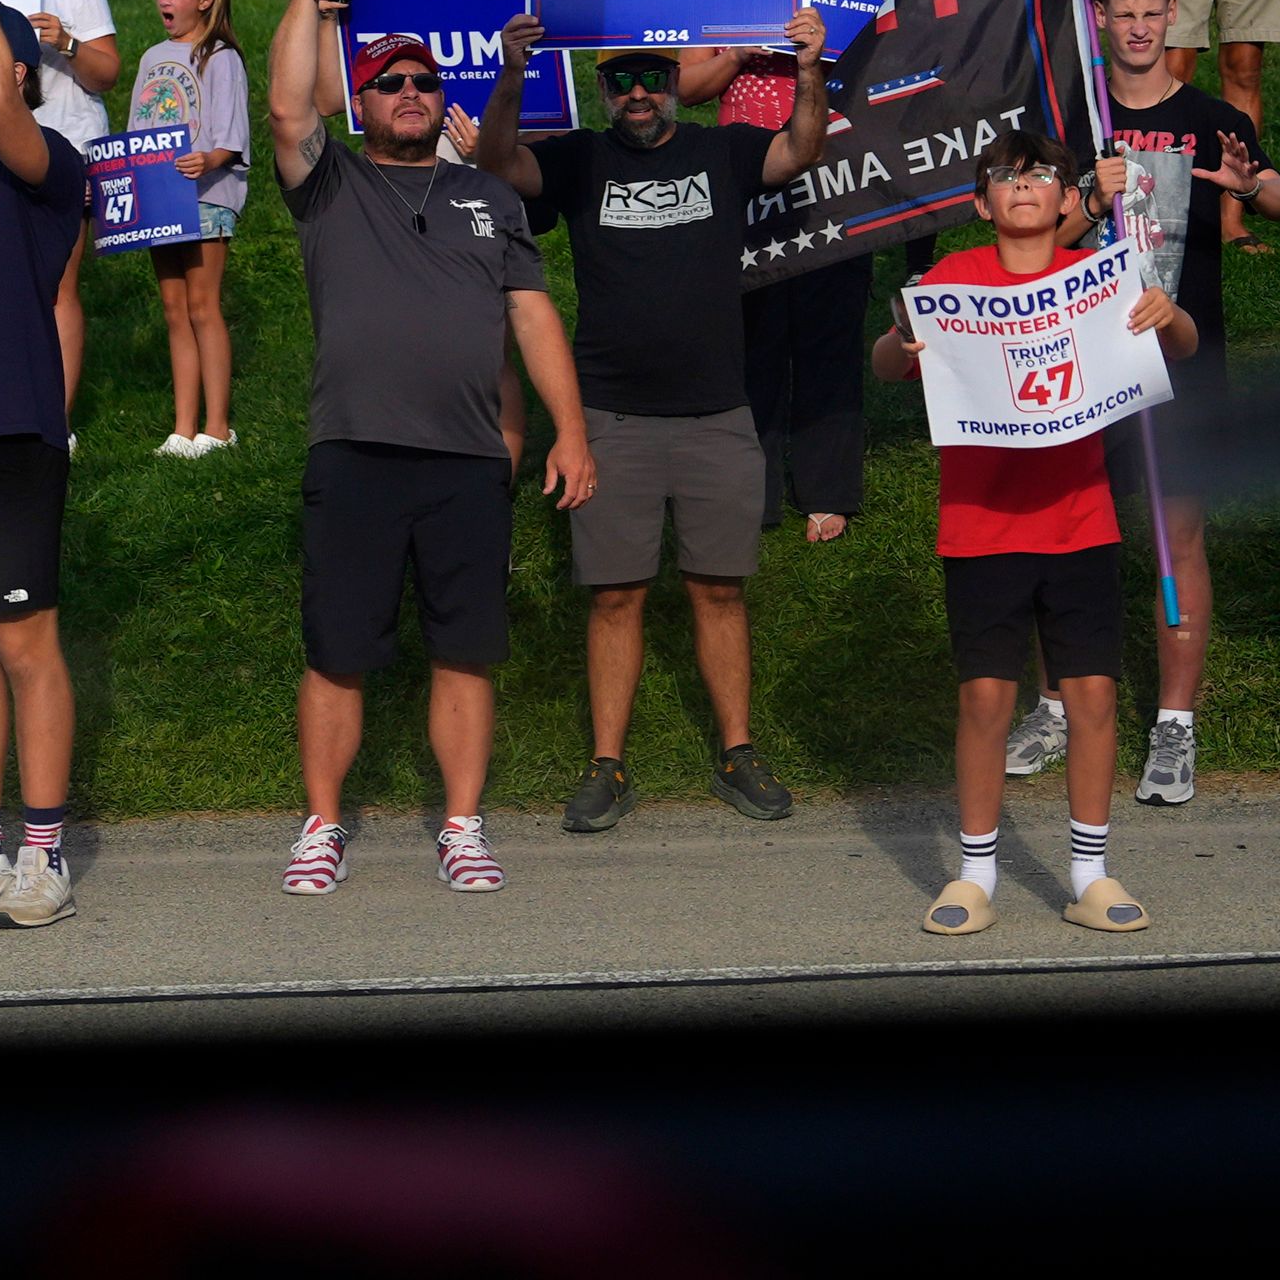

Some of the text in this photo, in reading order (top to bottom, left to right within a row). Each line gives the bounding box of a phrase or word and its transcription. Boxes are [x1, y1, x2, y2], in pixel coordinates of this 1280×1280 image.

[643, 29, 690, 42] 2024
[460, 71, 496, 80] GREAT
[87, 131, 185, 164] YOUR PART
[1180, 133, 1197, 156] 2
[128, 150, 176, 167] TODAY
[100, 176, 132, 191] TRUMP
[105, 193, 134, 224] 47
[913, 248, 1130, 318] DO YOUR PART
[935, 279, 1120, 336] VOLUNTEER TODAY
[1008, 336, 1070, 361] TRUMP
[1015, 351, 1068, 368] FORCE
[1017, 360, 1074, 406] 47
[958, 383, 1144, 436] TRUMPFORCE47.COM
